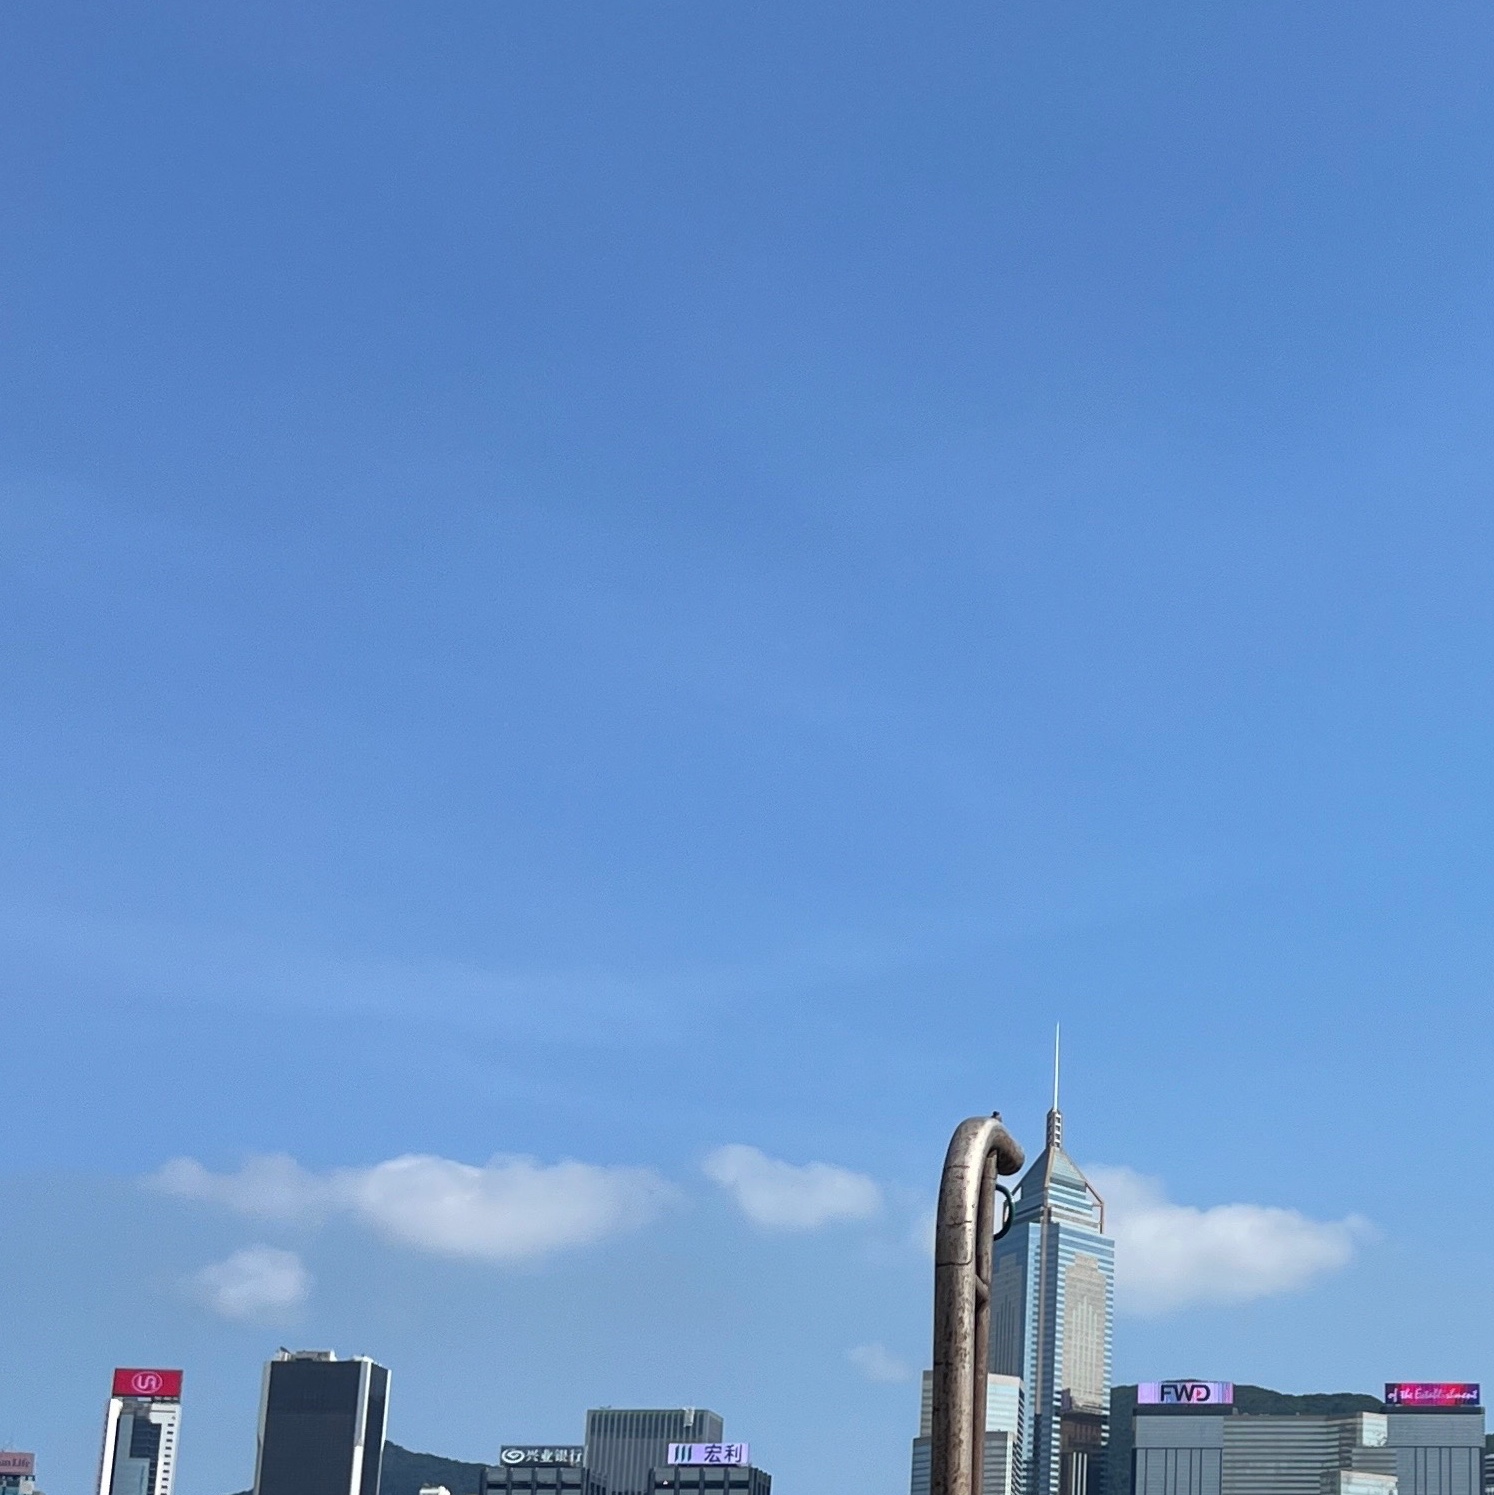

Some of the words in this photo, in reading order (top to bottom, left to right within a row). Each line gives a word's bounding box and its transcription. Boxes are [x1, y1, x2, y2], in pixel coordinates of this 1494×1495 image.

[1160, 1384, 1211, 1402] FWD
[1400, 1387, 1413, 1399] the
[525, 1448, 583, 1465] 兴业银行
[704, 1444, 743, 1463] 宏利
